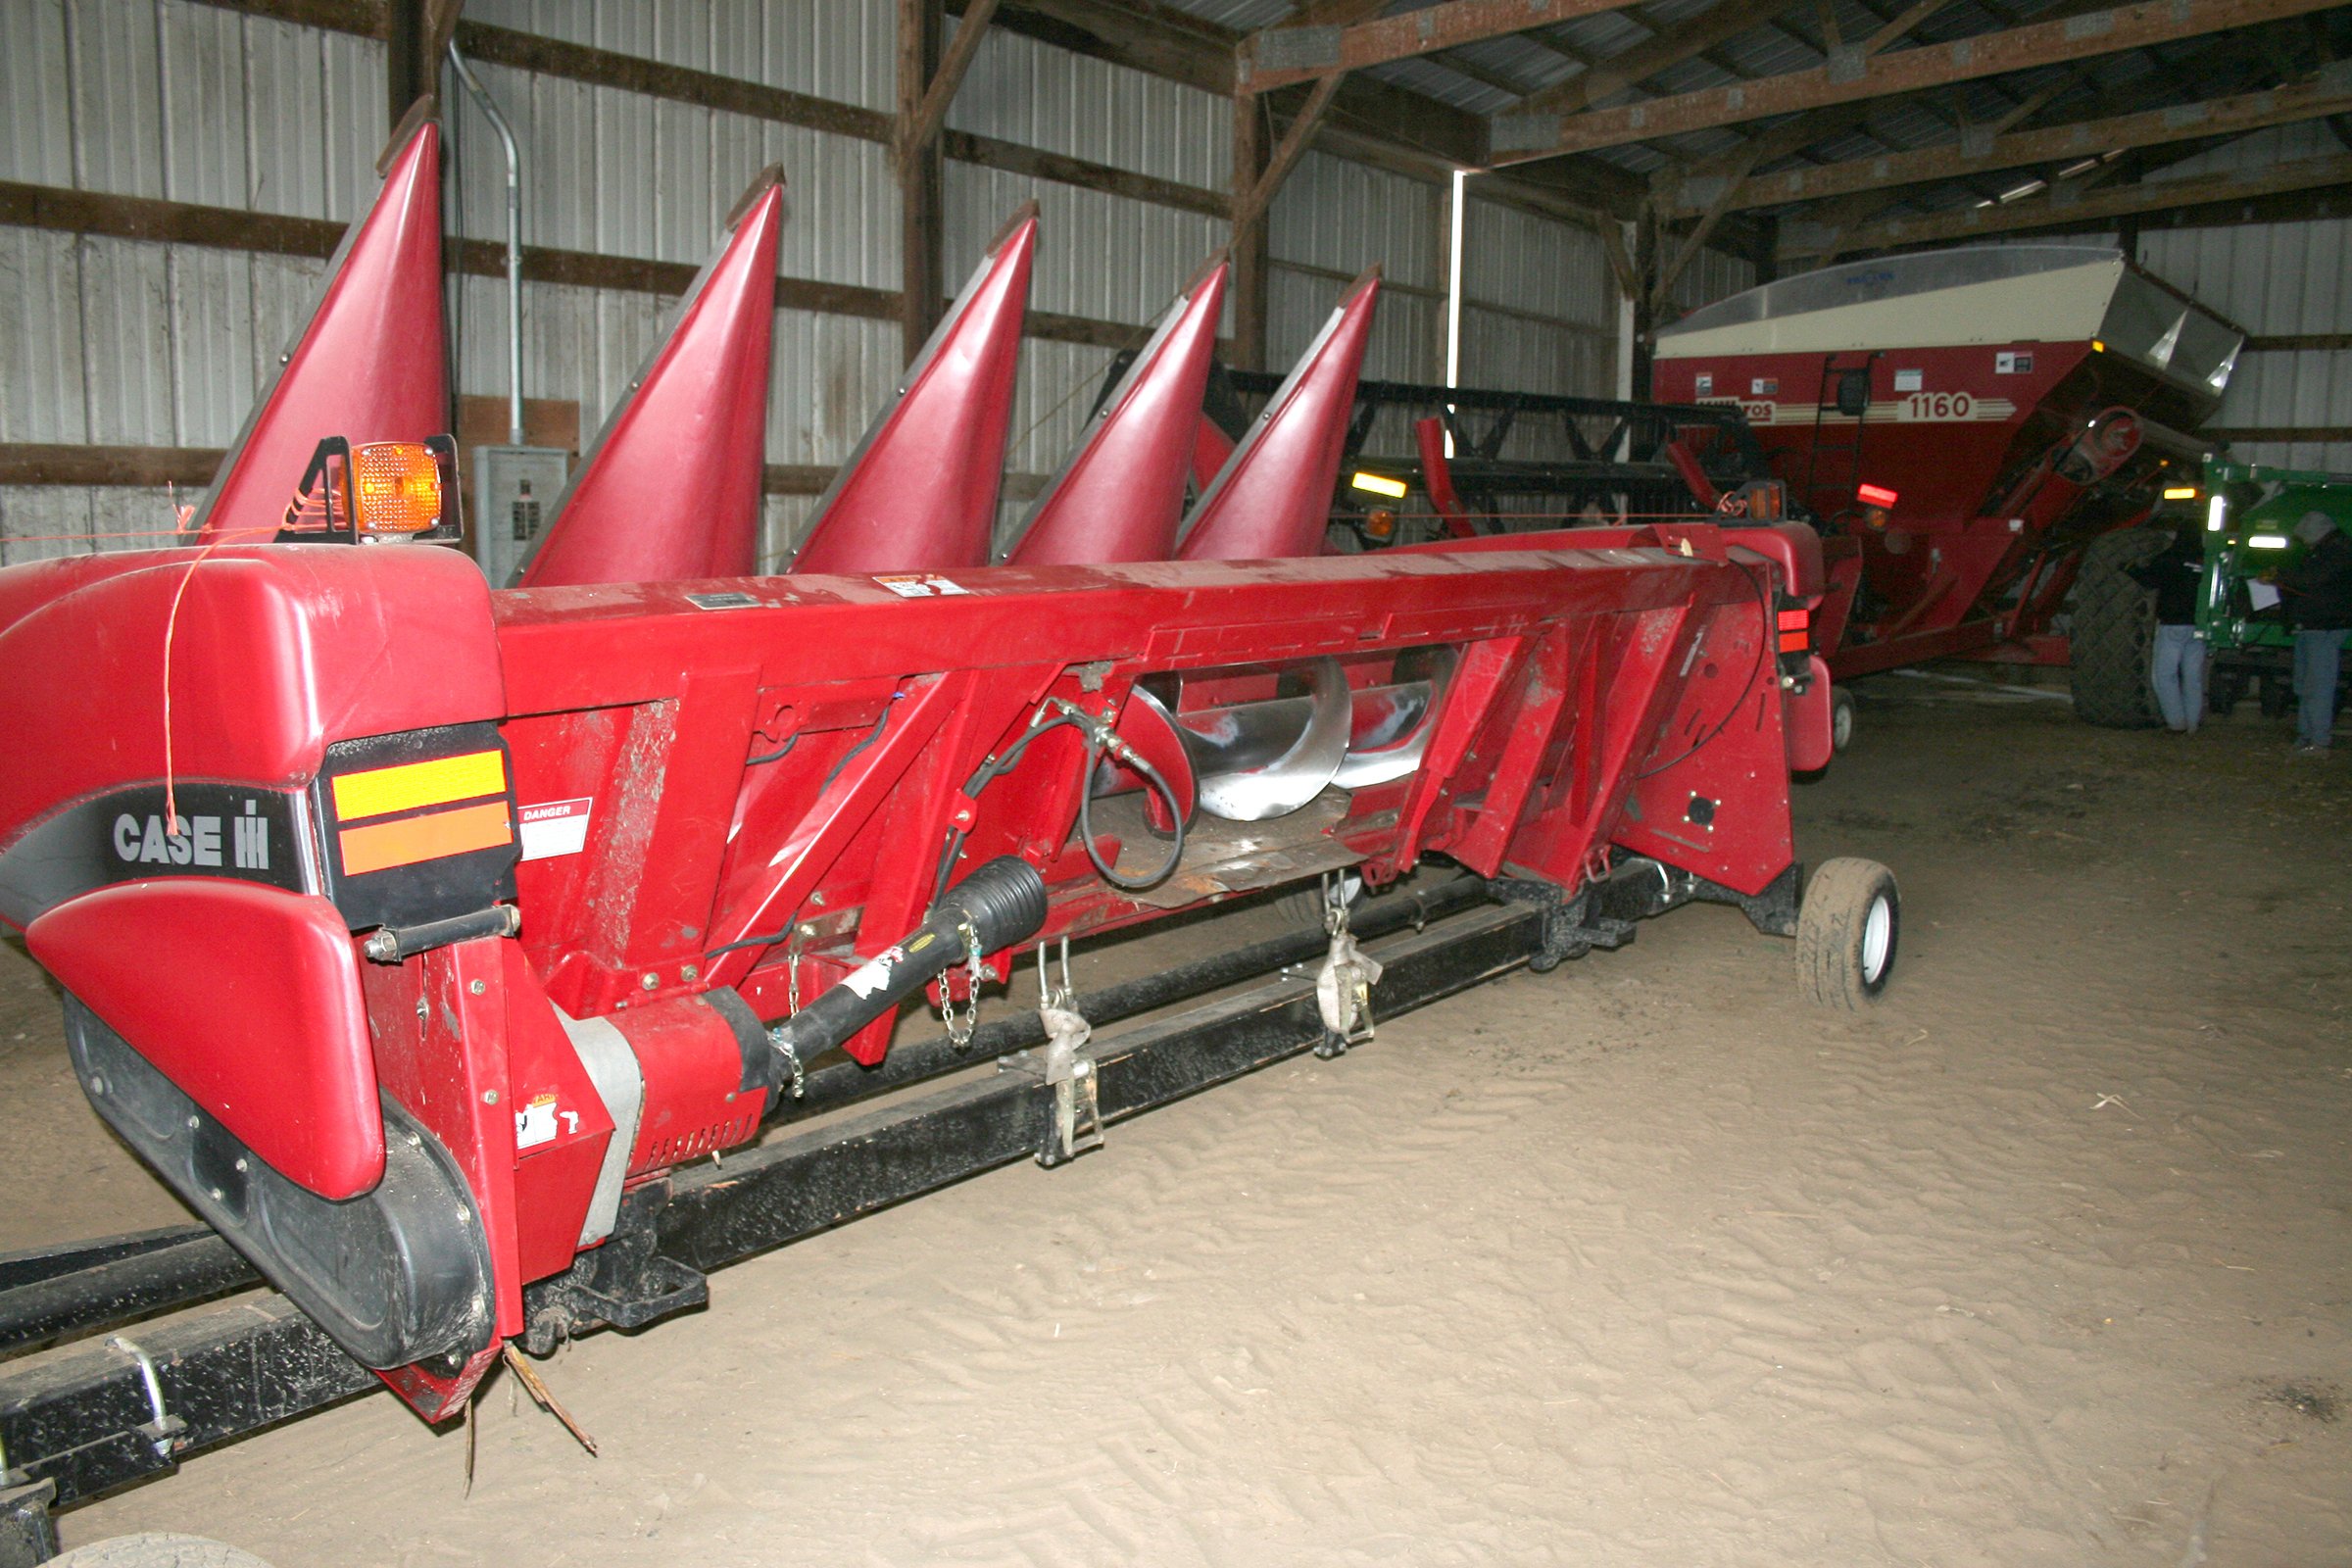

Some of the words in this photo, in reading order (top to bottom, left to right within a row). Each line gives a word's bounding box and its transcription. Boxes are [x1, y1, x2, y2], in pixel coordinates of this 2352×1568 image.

[1911, 395, 1969, 417] 1160
[523, 806, 571, 821] DANGER
[114, 813, 222, 867] CASE
